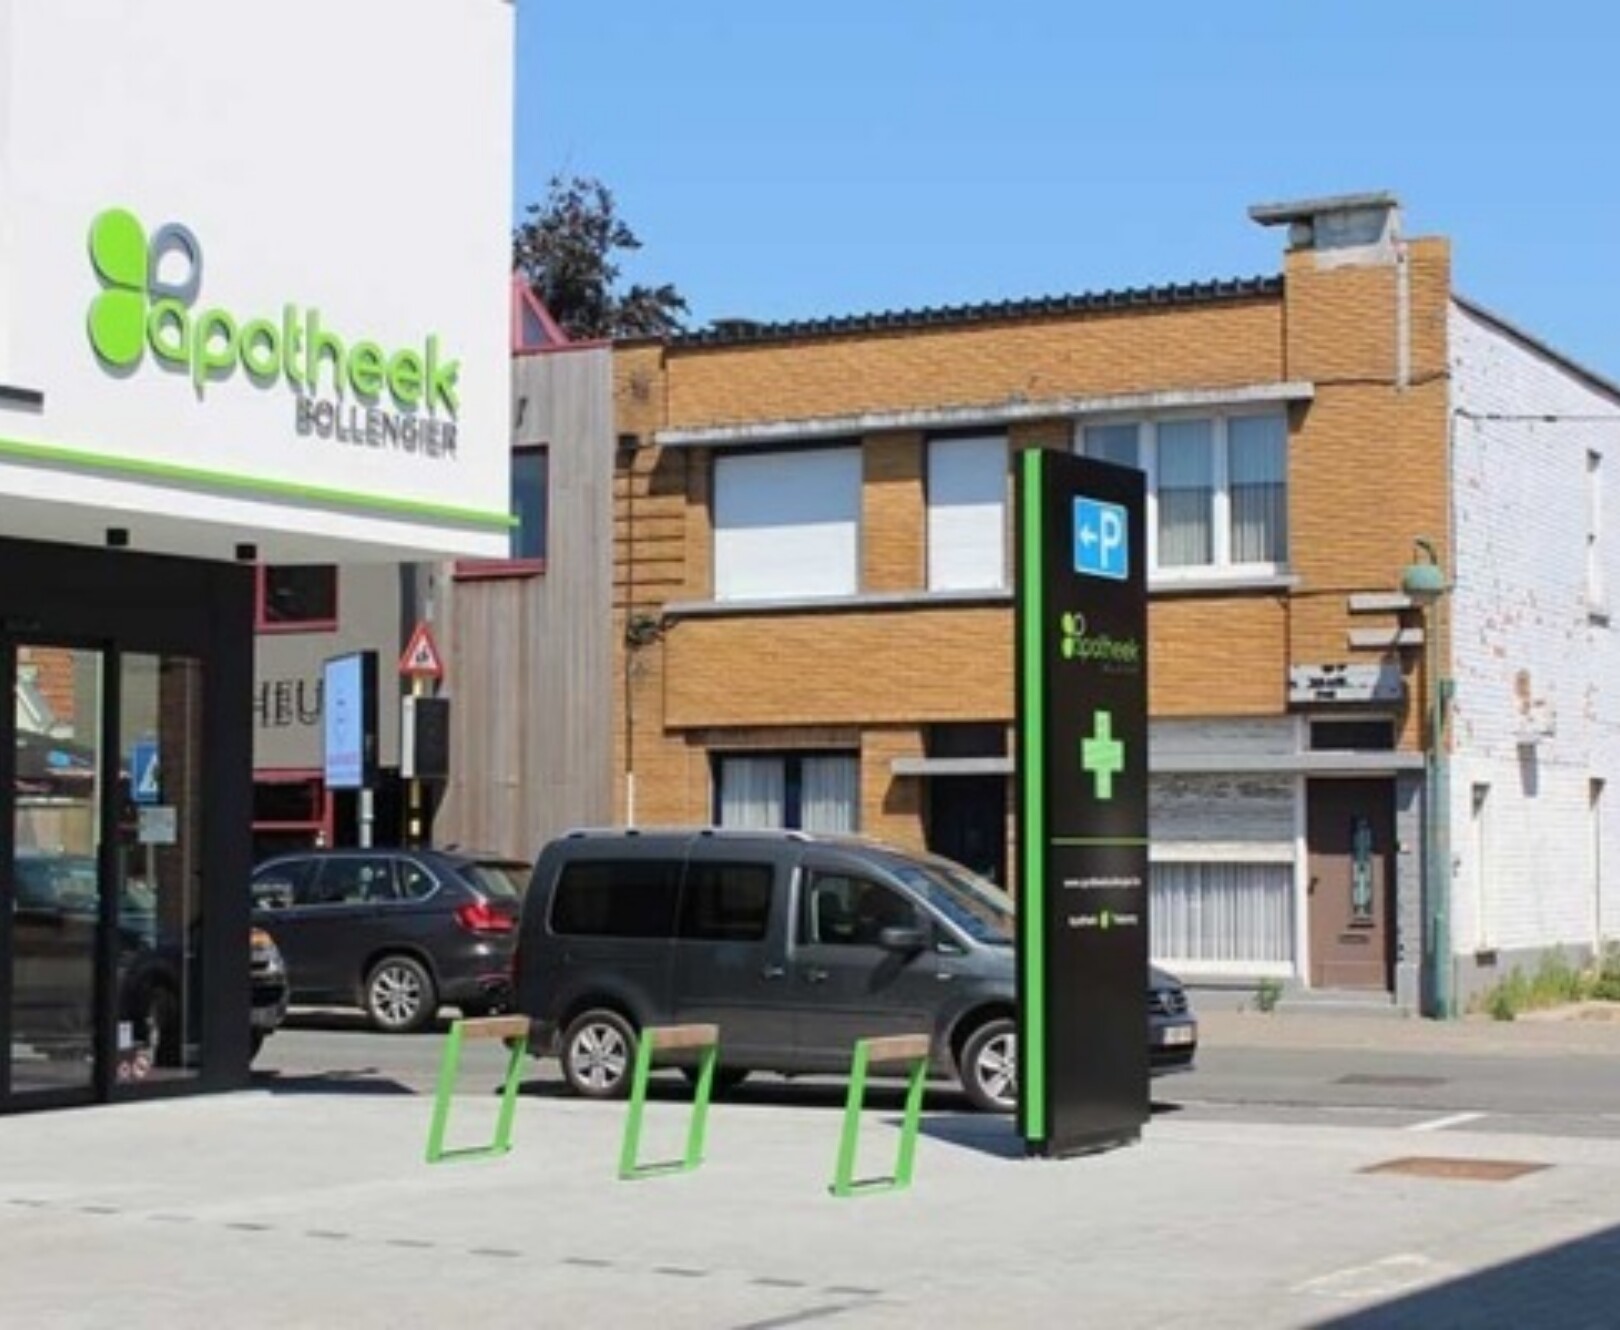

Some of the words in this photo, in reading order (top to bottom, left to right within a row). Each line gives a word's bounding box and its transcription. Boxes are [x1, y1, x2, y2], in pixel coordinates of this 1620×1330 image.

[146, 299, 458, 421] apotheek
[296, 397, 457, 460] BOLLENGIER
[1101, 510, 1122, 568] P
